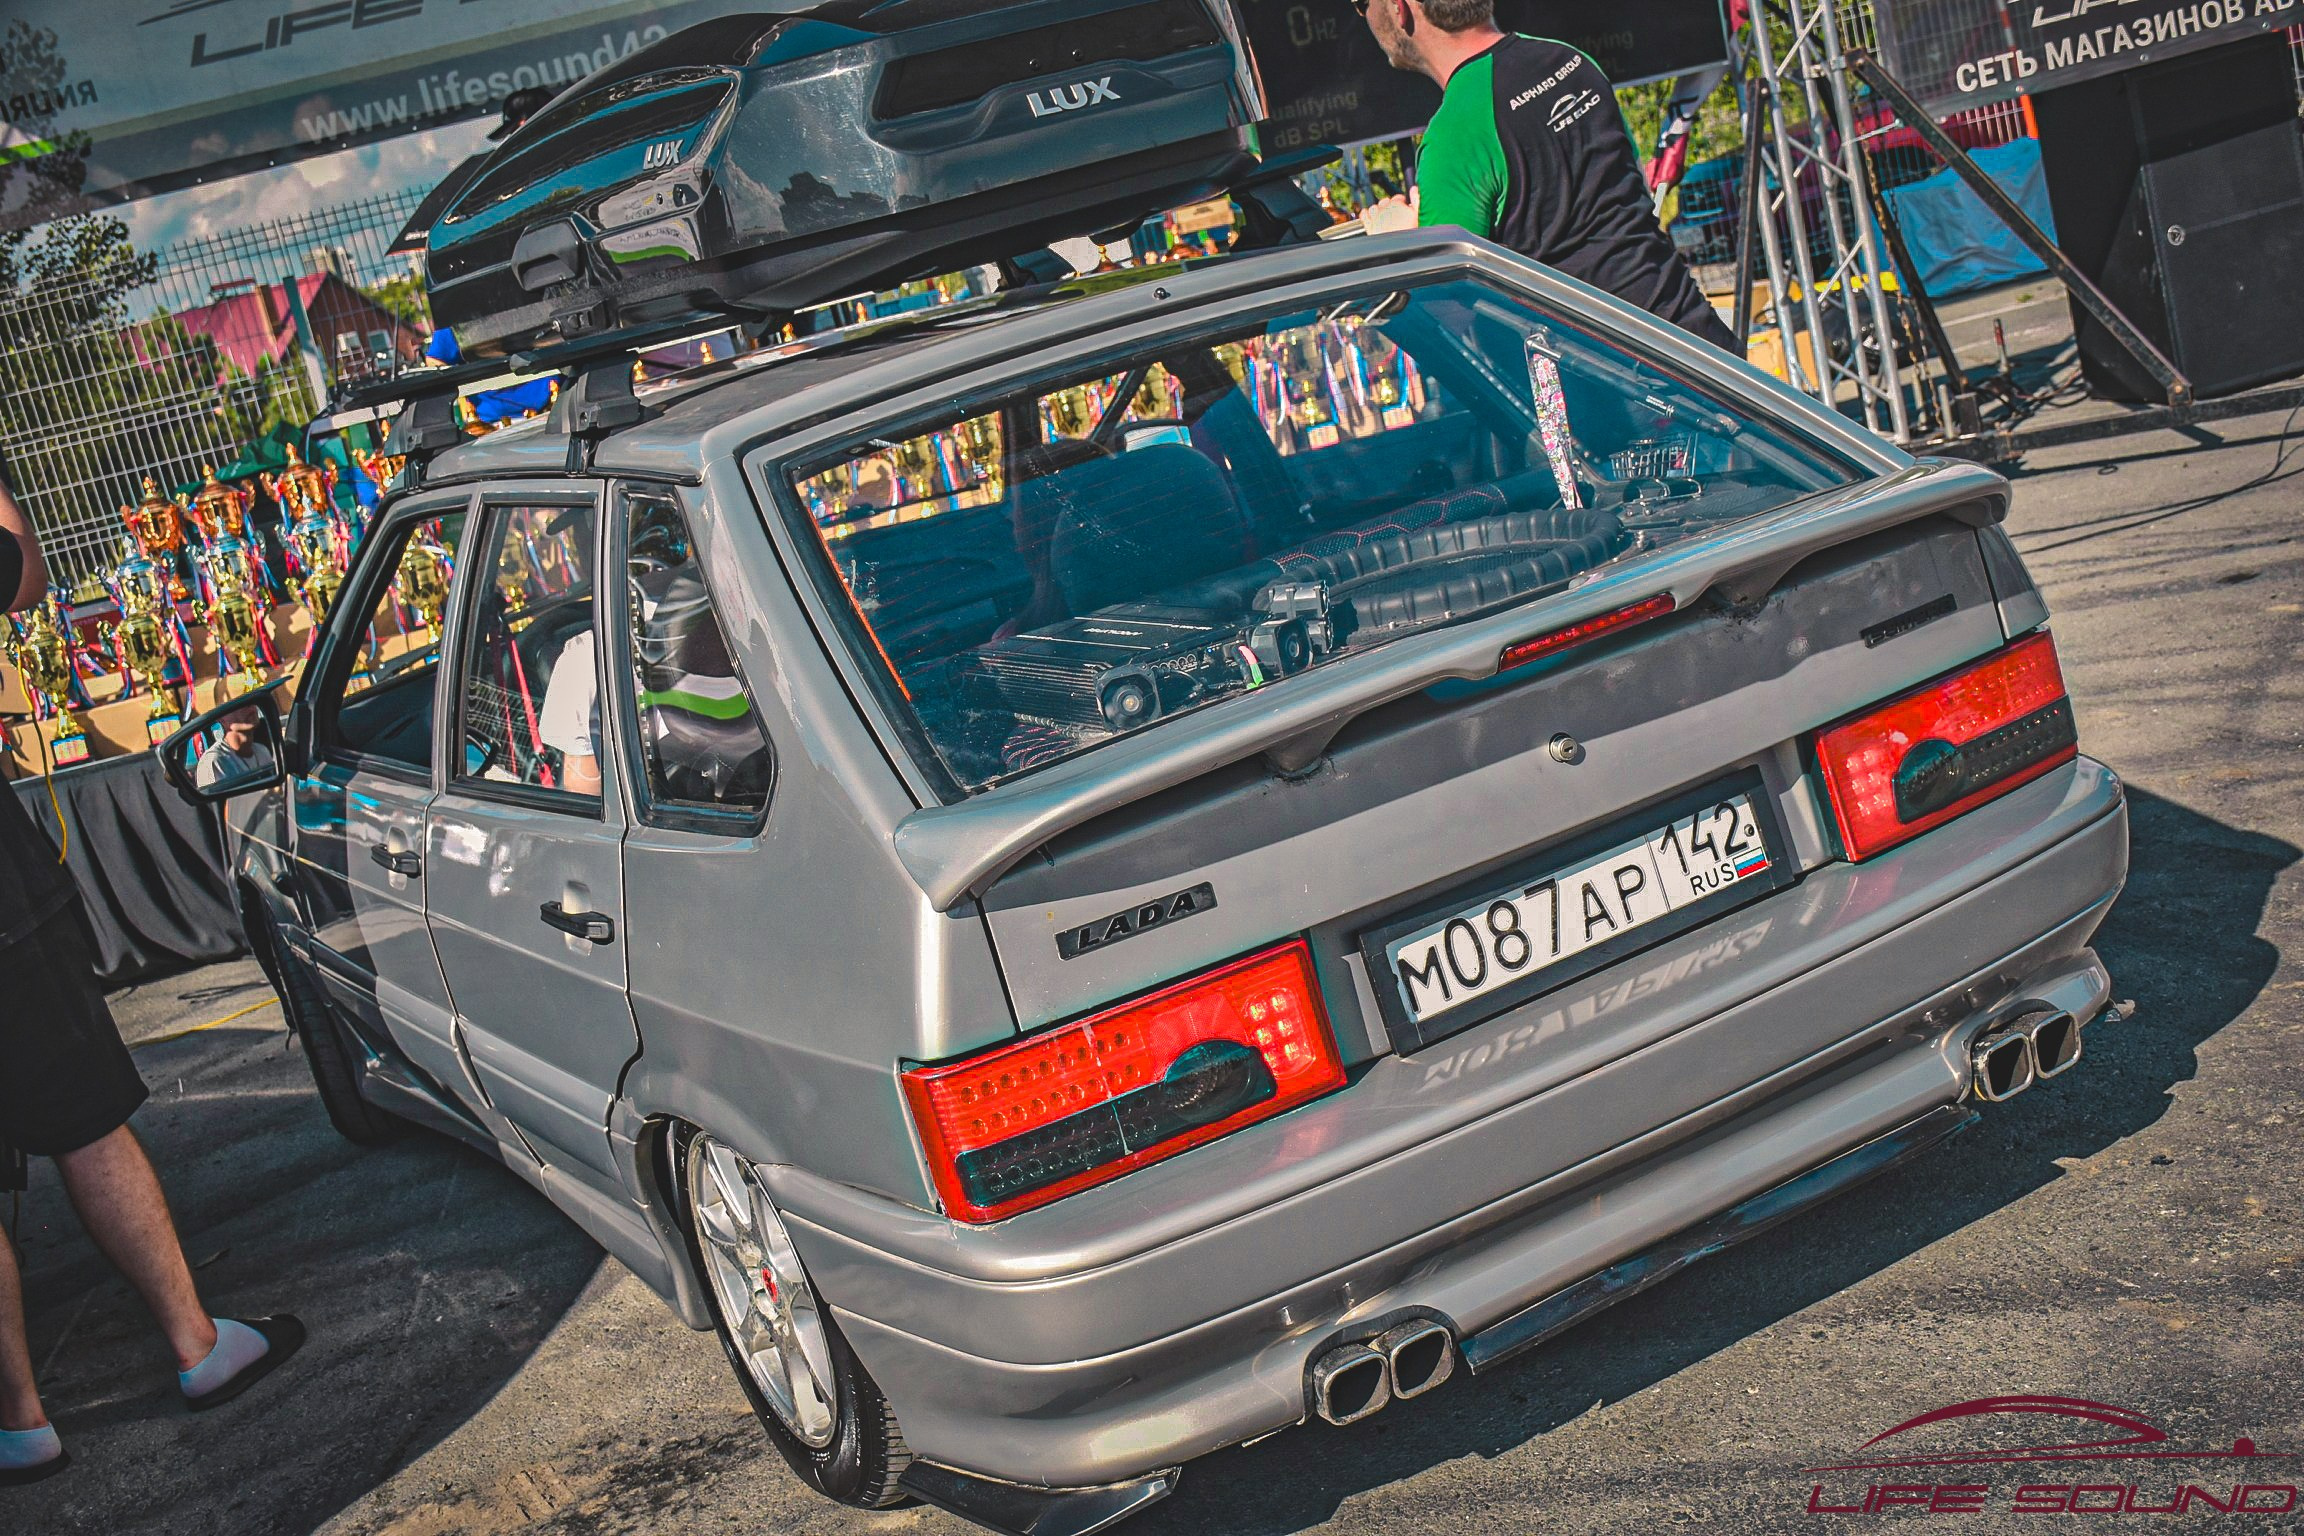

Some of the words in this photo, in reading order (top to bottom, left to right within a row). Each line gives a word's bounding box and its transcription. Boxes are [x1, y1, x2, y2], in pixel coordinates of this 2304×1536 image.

[1956, 50, 2038, 92] СЕТЬ
[2044, 0, 2244, 70] МАГАЗИНОВ
[1026, 77, 1121, 119] LUX
[1509, 77, 1557, 111] ALPHARD
[1554, 54, 1582, 81] GROUP
[1271, 91, 1358, 122] ualifying
[1307, 117, 1350, 141] SPL
[642, 139, 685, 171] LUX
[1659, 801, 1750, 875] 142
[1690, 863, 1736, 897] RUS
[1078, 892, 1197, 950] LADA
